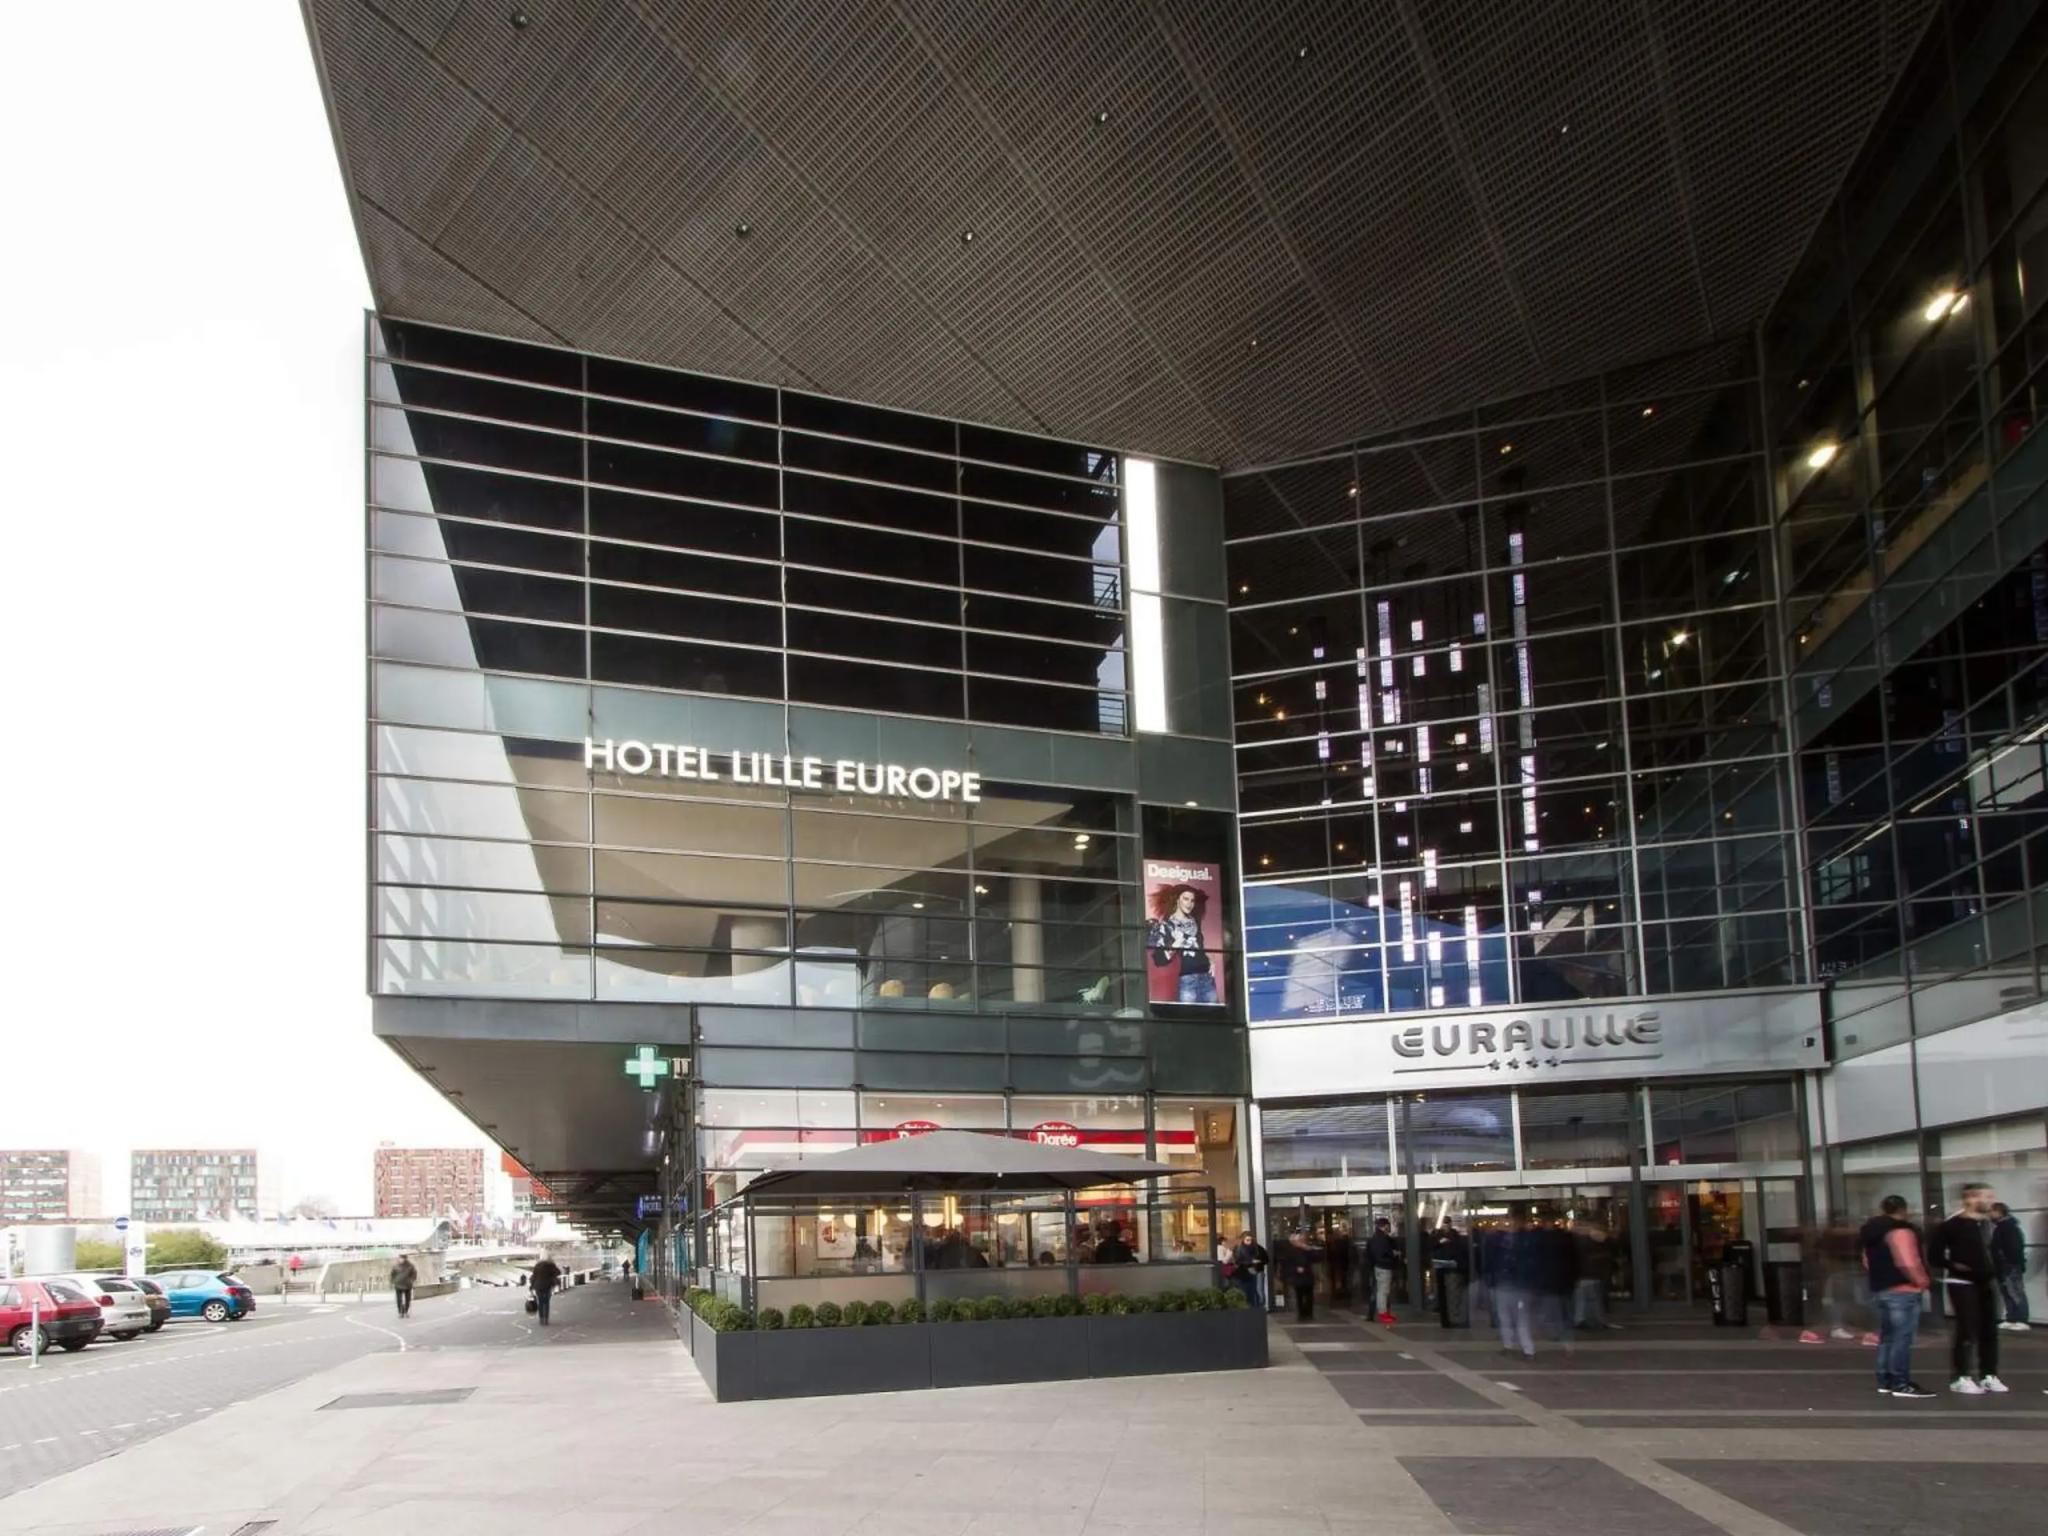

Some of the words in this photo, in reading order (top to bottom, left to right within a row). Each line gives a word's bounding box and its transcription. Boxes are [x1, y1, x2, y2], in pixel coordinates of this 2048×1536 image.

[584, 736, 719, 780] HOTEL
[732, 749, 823, 789] LILLE
[836, 759, 981, 803] EUROPE
[1391, 1010, 1663, 1058] EURALILLE
